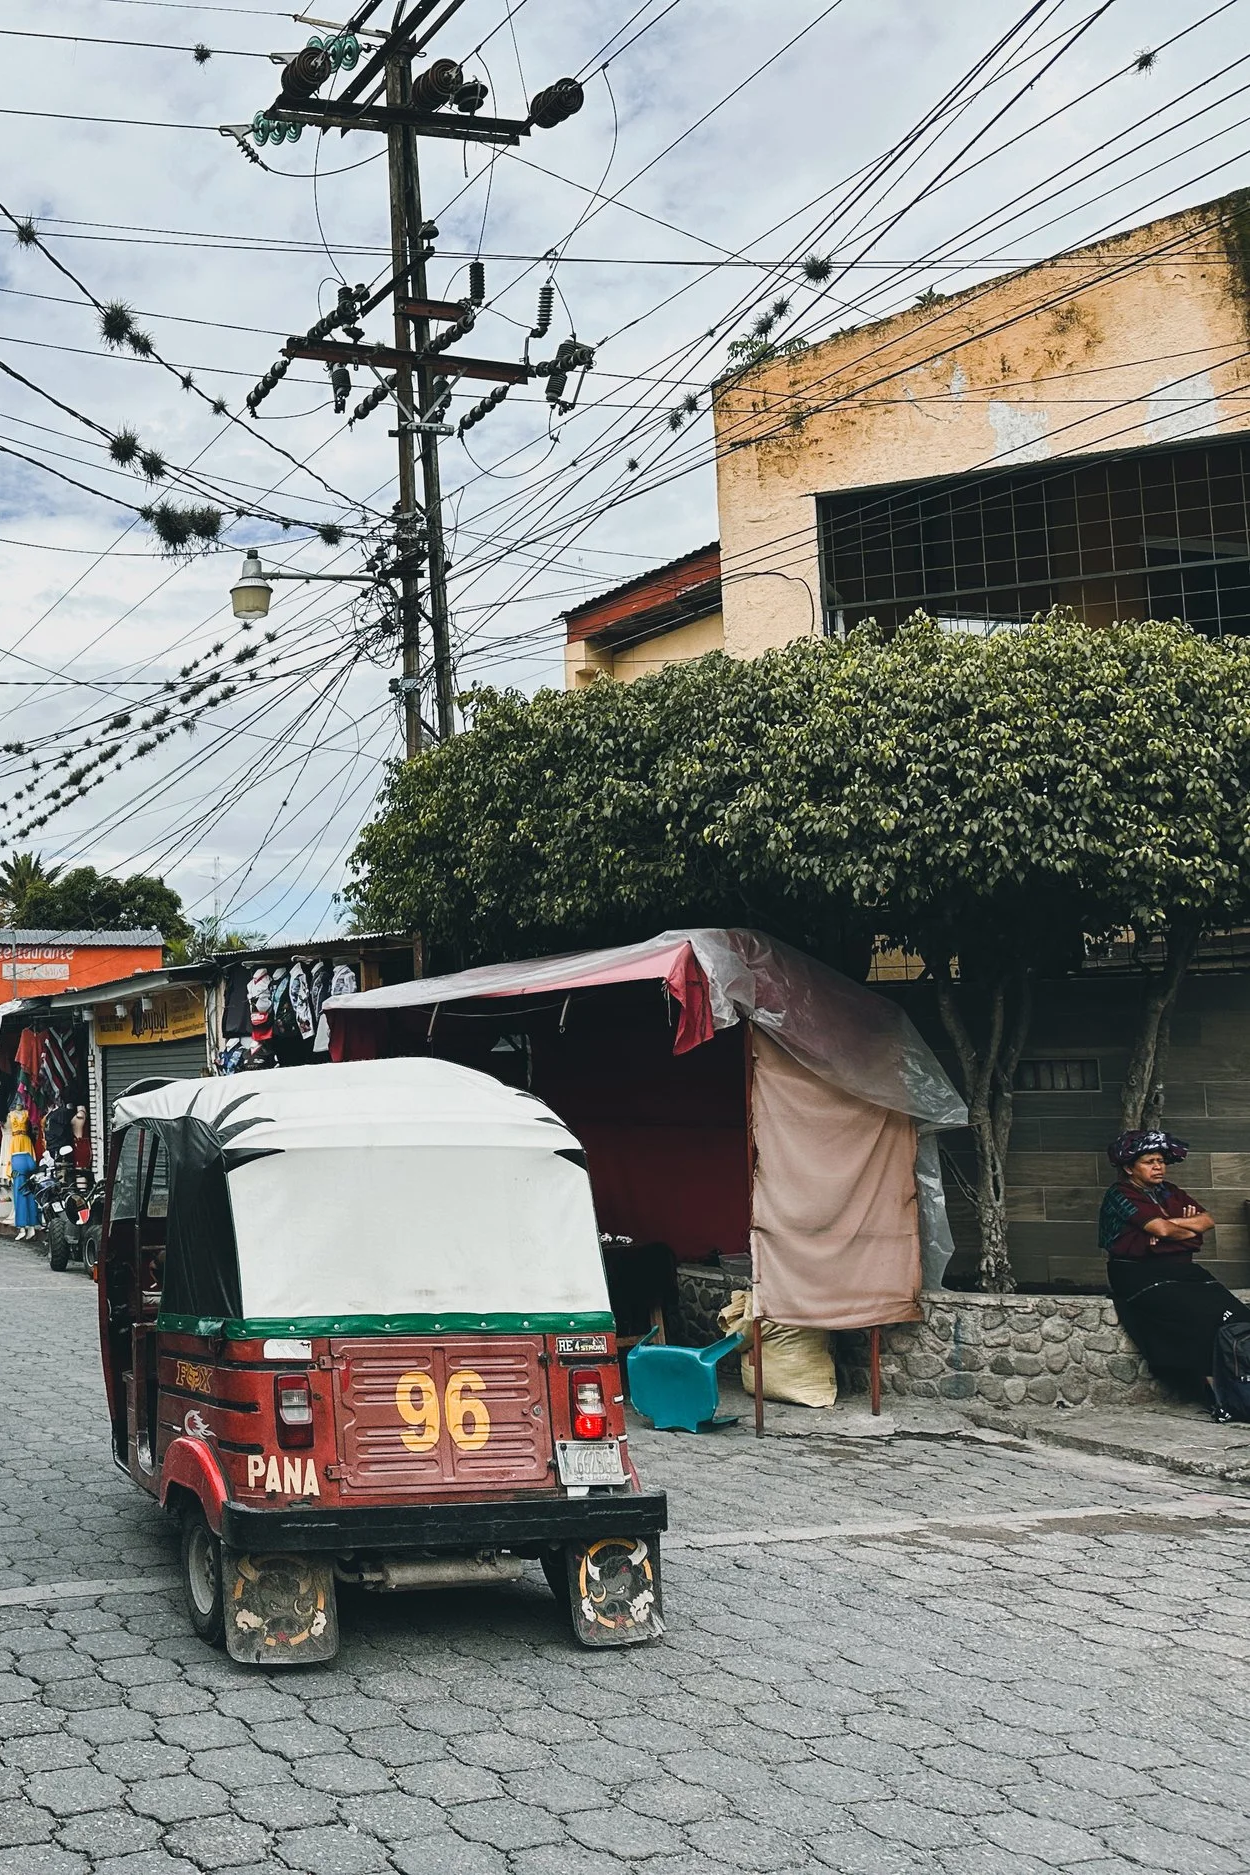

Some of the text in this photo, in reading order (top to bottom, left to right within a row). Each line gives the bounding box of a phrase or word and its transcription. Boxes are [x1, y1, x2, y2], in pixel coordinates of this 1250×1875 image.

[558, 1339, 573, 1352] RE
[574, 1340, 580, 1351] 4
[395, 1370, 491, 1452] 96
[247, 1454, 321, 1497] PANA
